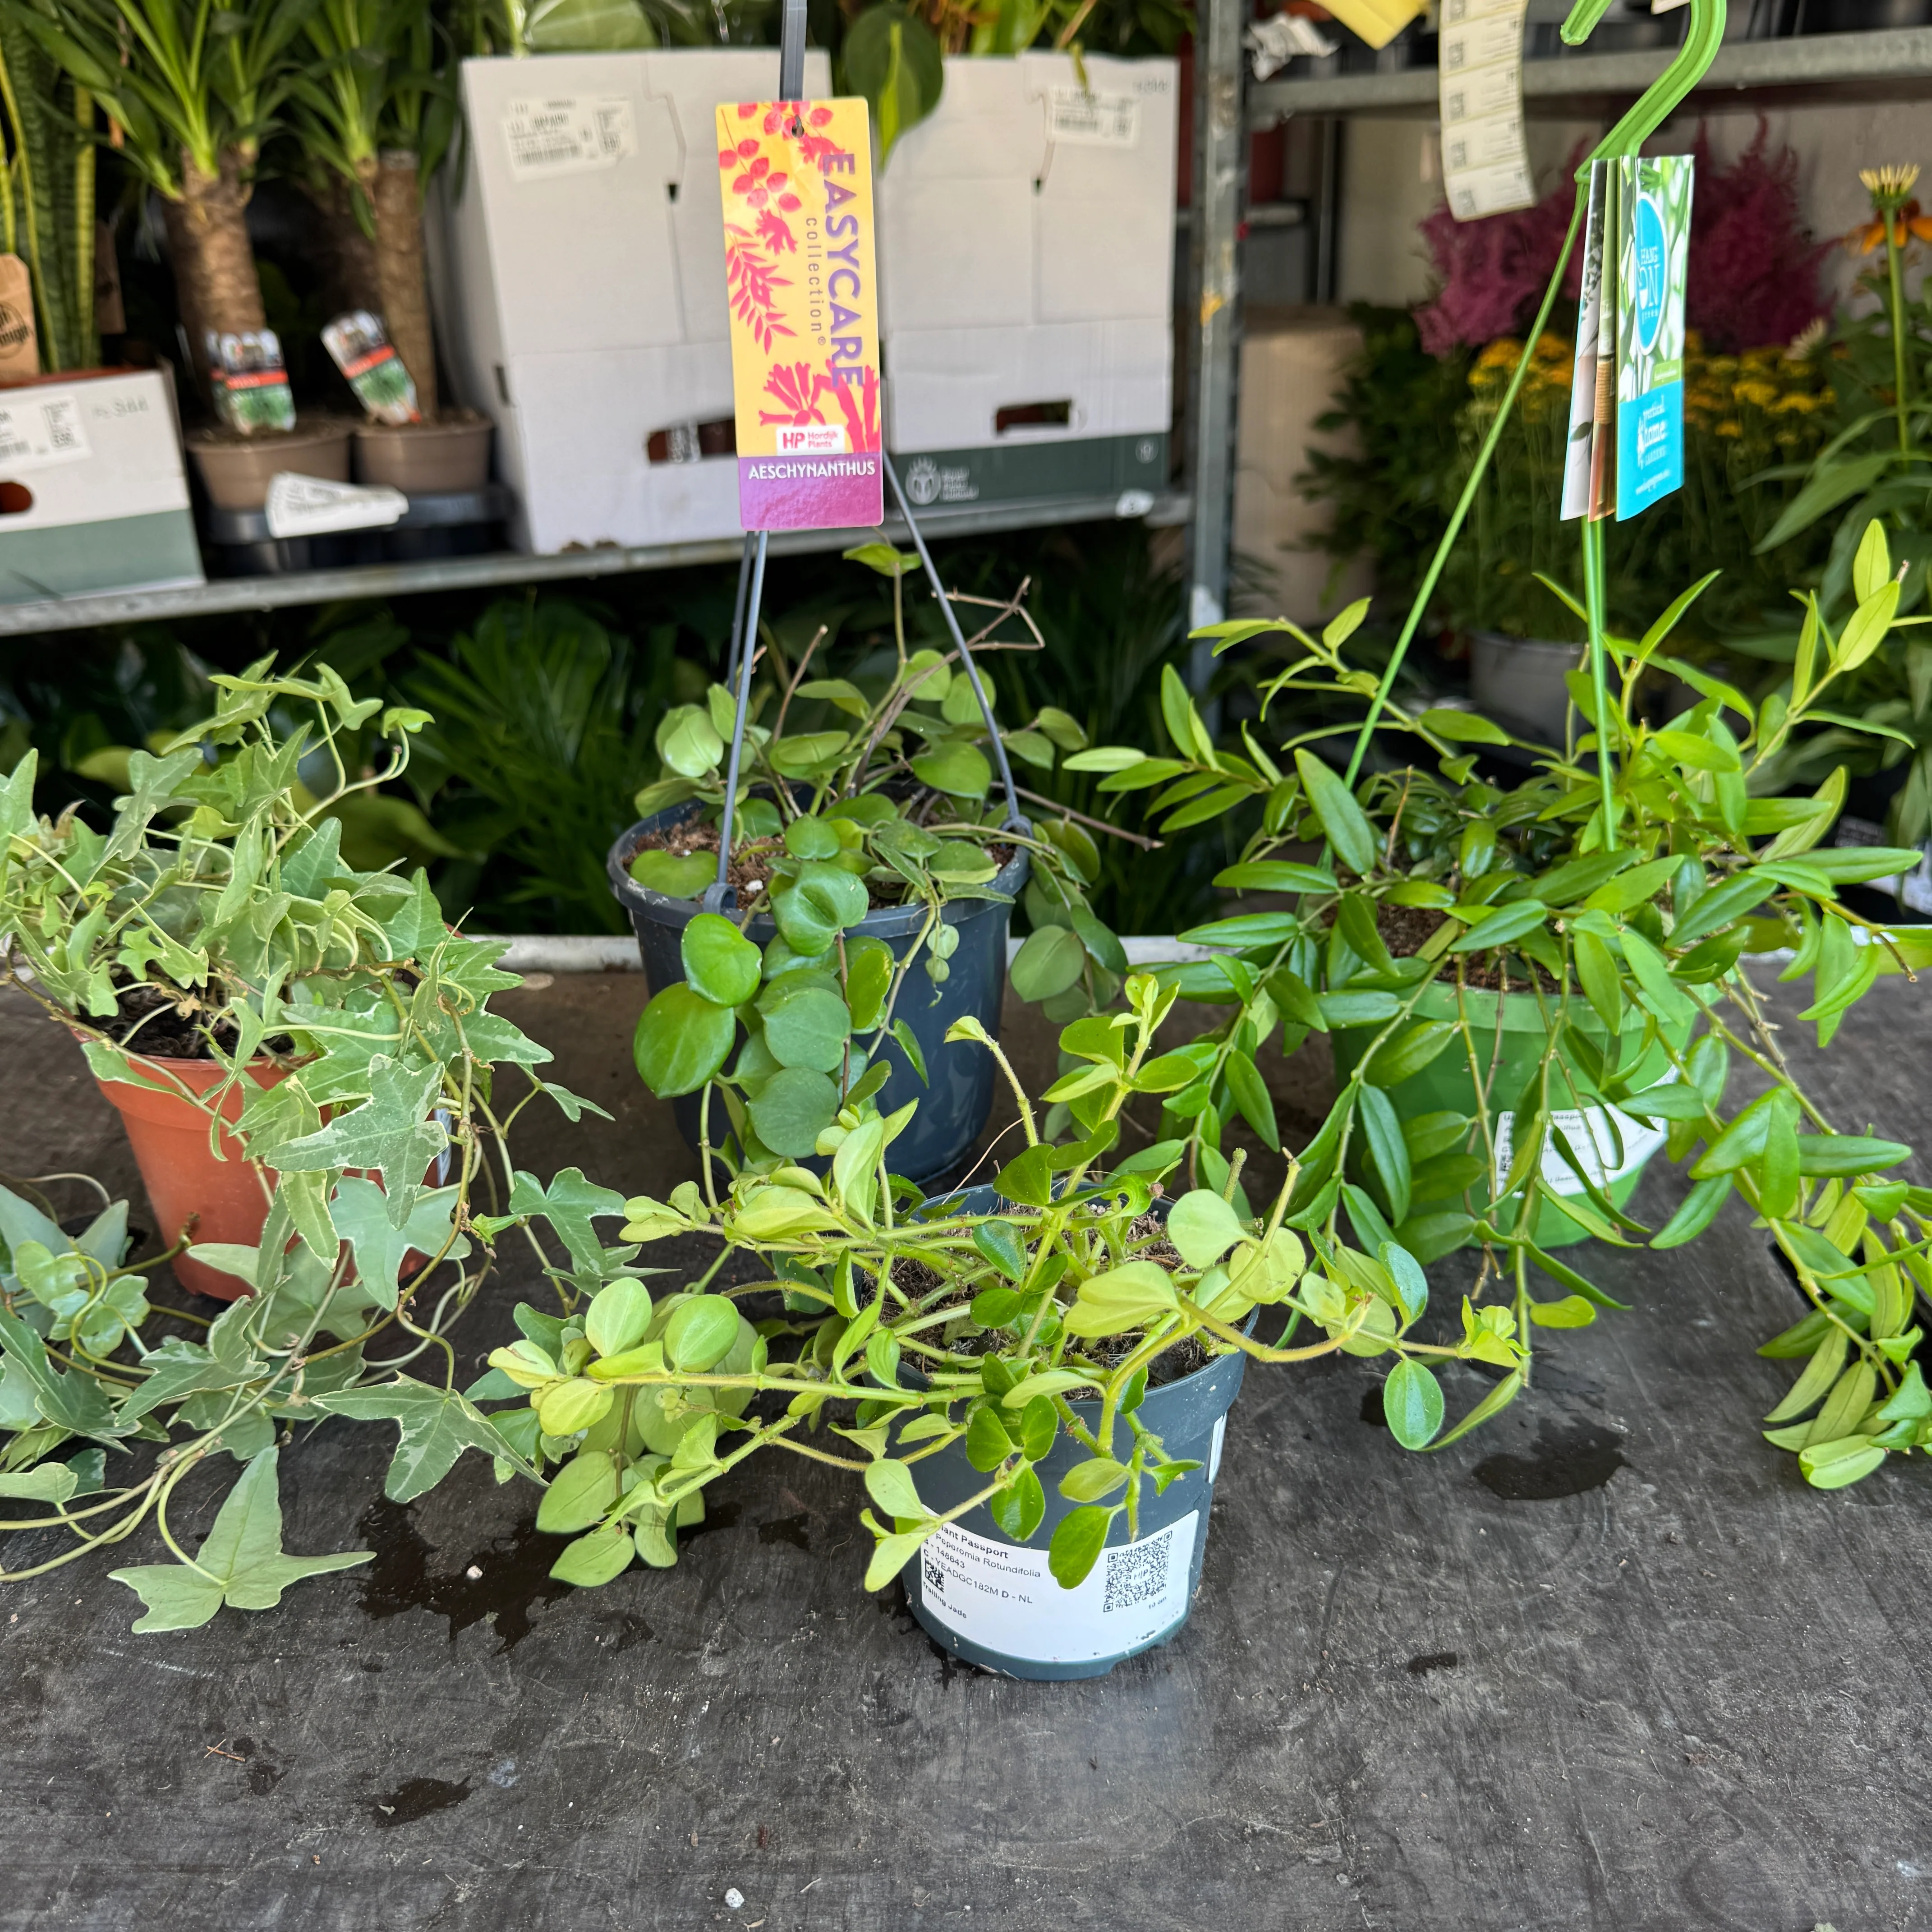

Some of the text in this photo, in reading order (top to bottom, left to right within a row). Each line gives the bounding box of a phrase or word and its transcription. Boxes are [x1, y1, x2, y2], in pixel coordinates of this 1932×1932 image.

[823, 153, 864, 388] EASYCARE
[783, 432, 805, 449] HP
[749, 460, 875, 479] AESCHYNANTHUS
[941, 1525, 1008, 1559] lant Passport
[936, 1546, 965, 1569] 148643
[983, 1558, 1040, 1578] Rotundifolia
[924, 1549, 929, 1557] C
[1018, 1594, 1033, 1604] NL
[948, 1604, 967, 1618] Jade
